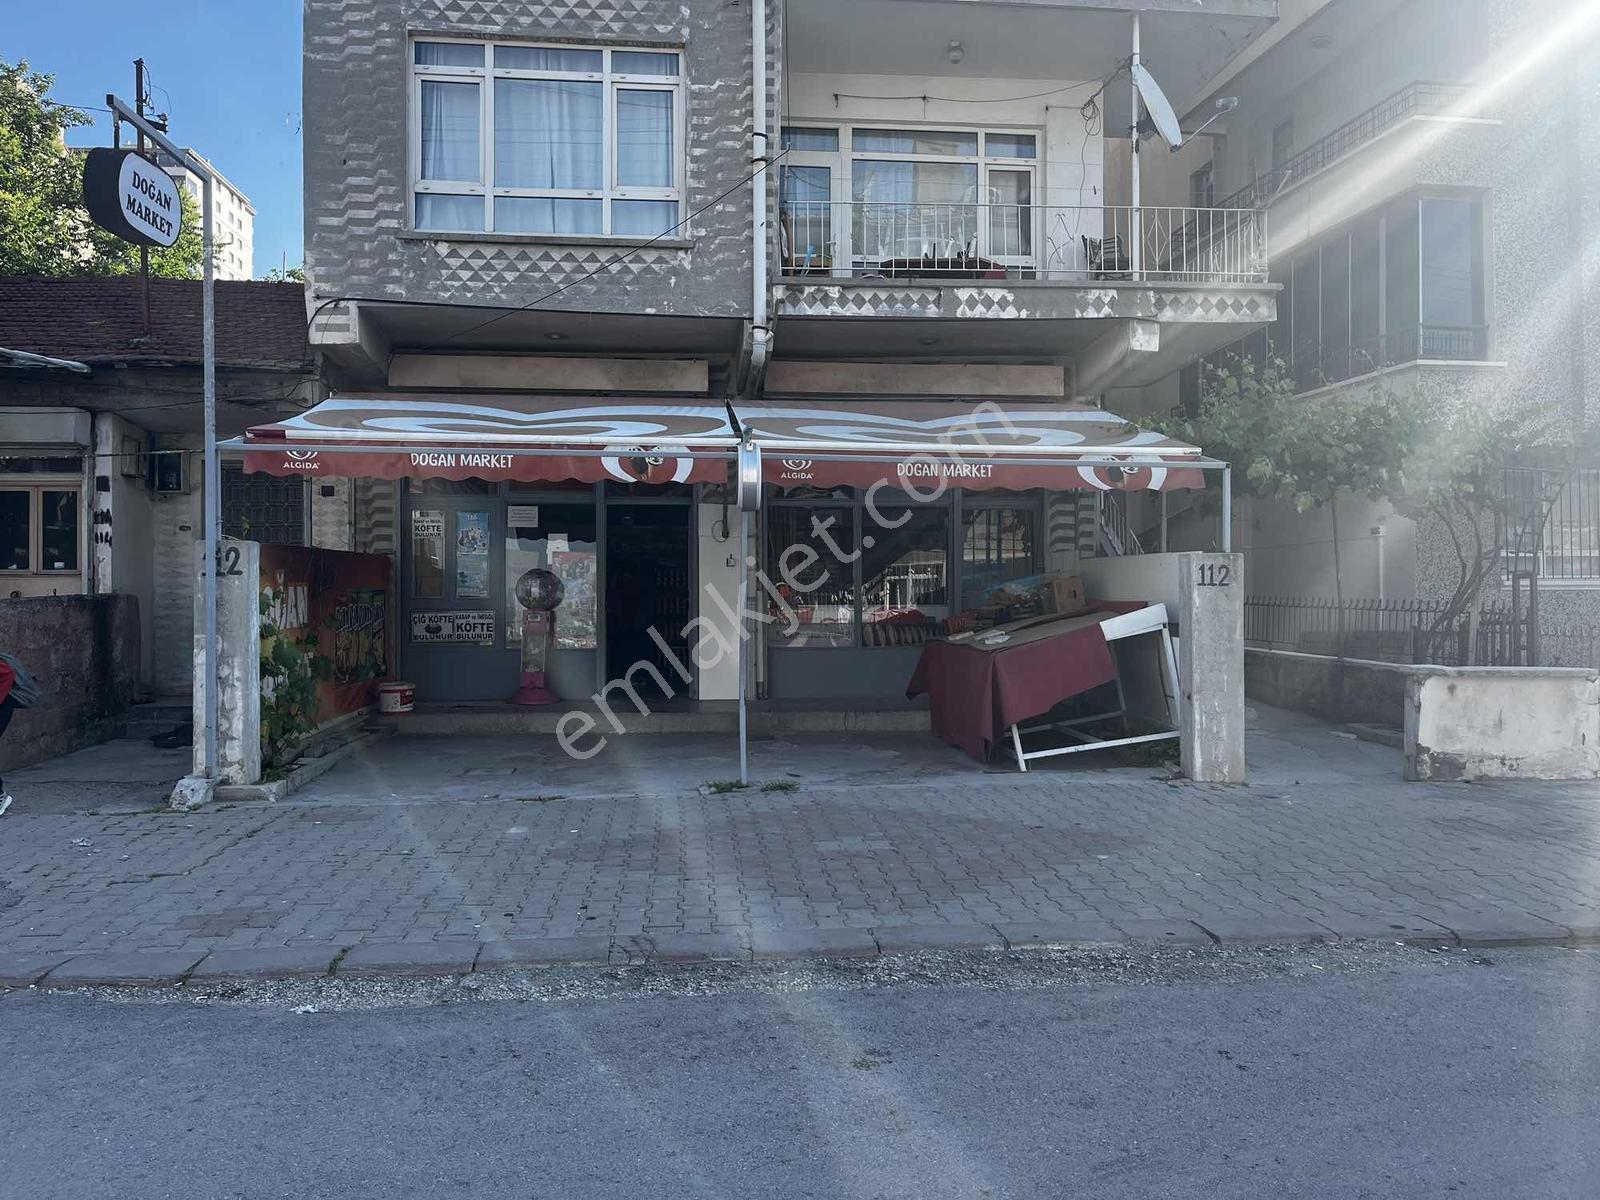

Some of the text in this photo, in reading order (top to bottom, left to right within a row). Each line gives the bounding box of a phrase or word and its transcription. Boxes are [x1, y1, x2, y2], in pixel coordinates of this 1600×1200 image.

[132, 170, 172, 212] DOĞAN
[126, 193, 173, 237] MARKET
[459, 454, 514, 468] MARKET
[942, 463, 993, 478] MARKET
[1196, 563, 1230, 587] 112
